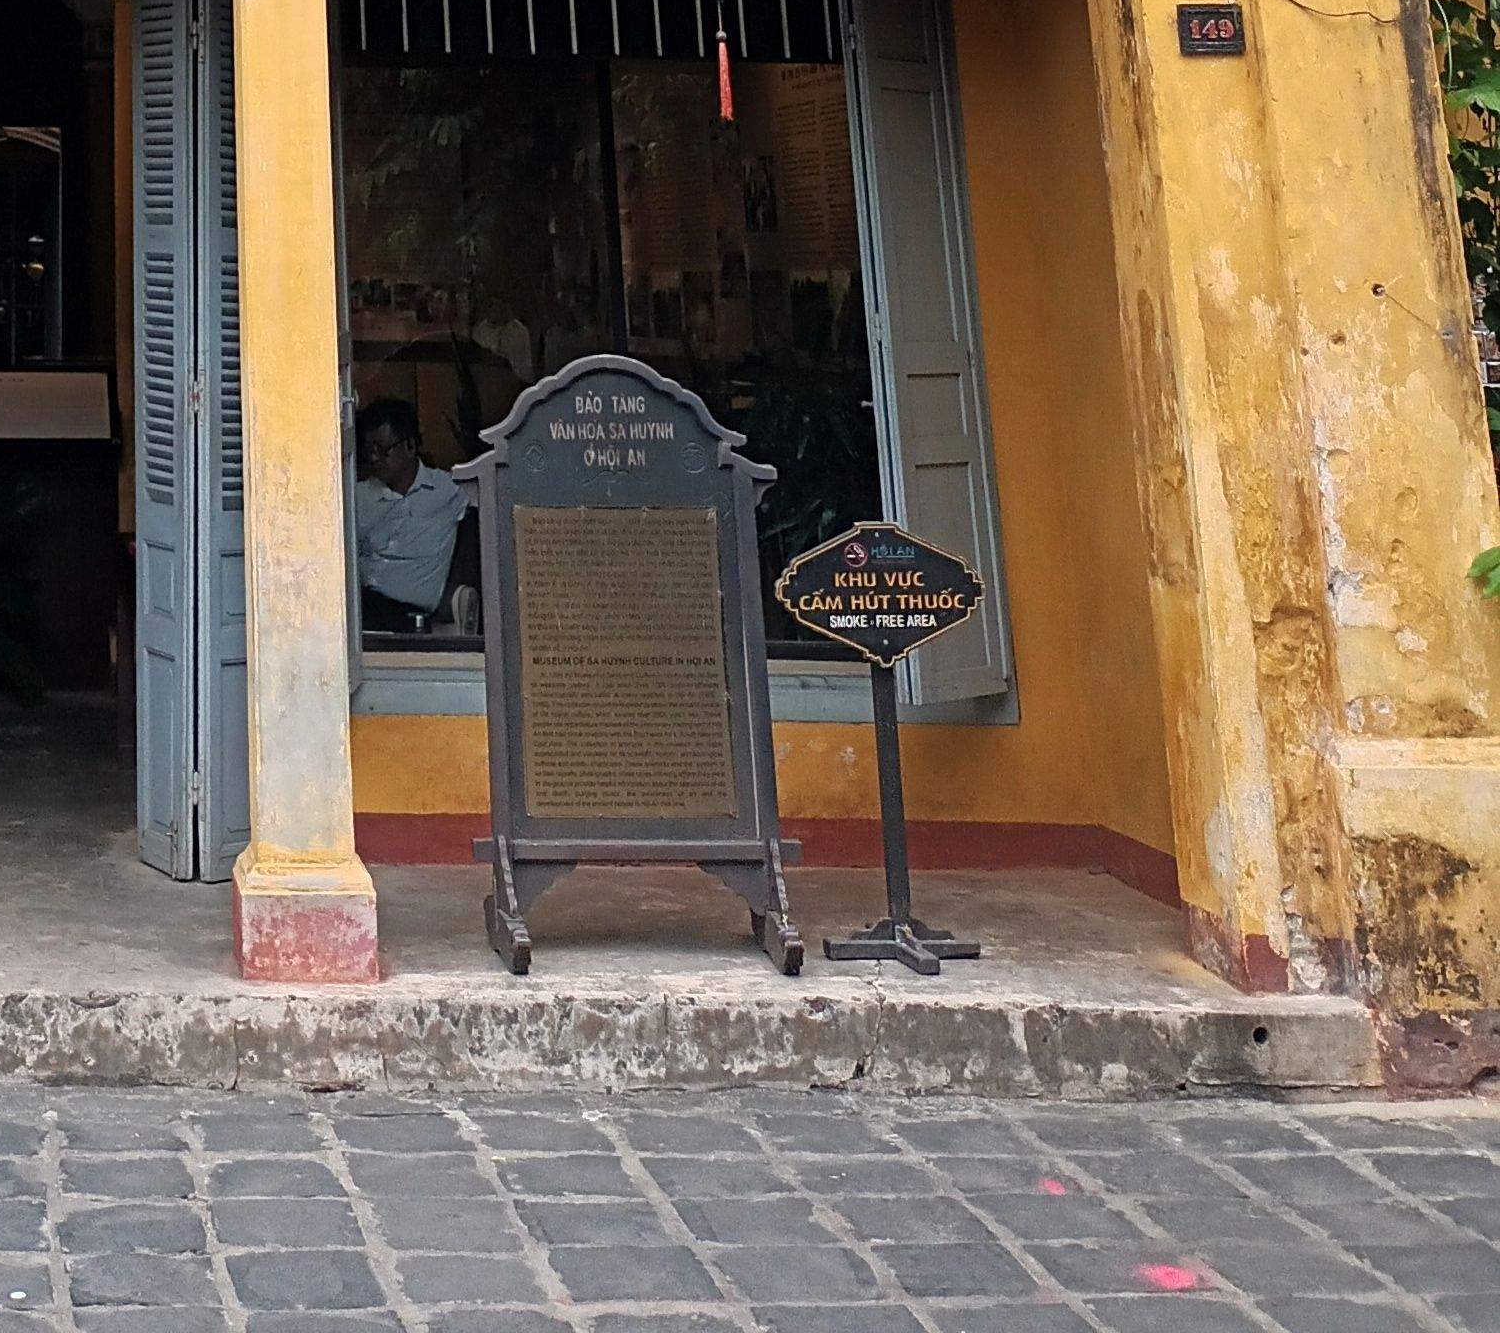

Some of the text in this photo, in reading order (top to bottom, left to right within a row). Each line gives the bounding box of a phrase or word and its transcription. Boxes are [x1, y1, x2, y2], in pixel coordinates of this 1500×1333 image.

[1189, 19, 1235, 39] 149
[575, 390, 603, 414] BẢO
[608, 421, 627, 440] SA
[627, 448, 646, 467] AN
[834, 570, 925, 590] KHU VỰC
[799, 587, 967, 610] CẤM HÚT THUỐC
[829, 614, 868, 629] SMOKE
[876, 614, 905, 629] FREE
[906, 614, 937, 628] AREA
[532, 656, 571, 666] MUSEUM
[573, 656, 585, 666] OF
[633, 656, 673, 666] CULTURE
[703, 656, 716, 666] AN
